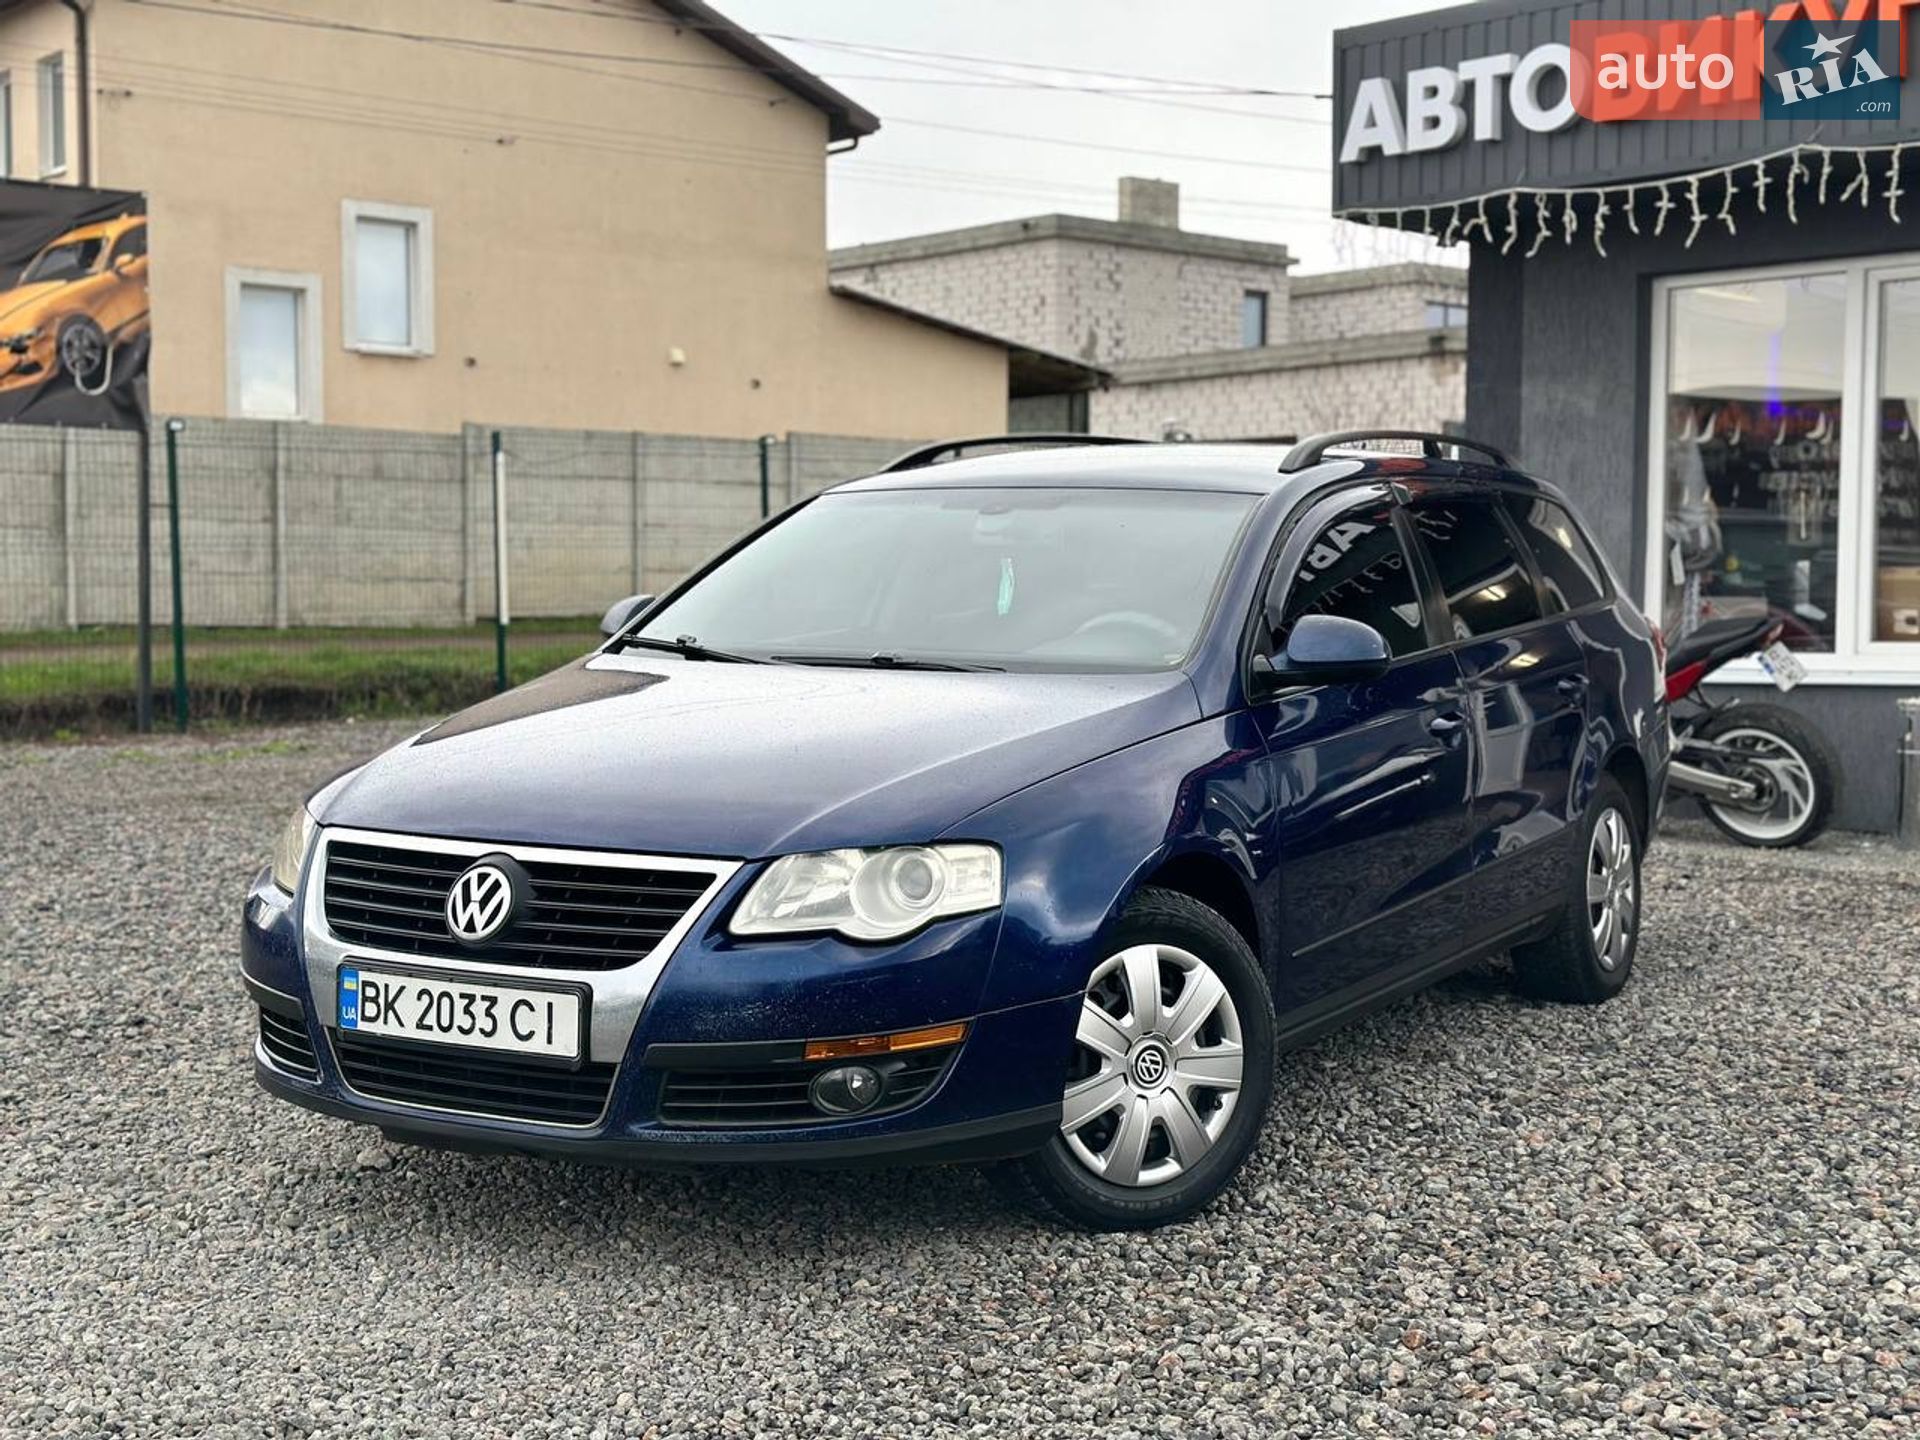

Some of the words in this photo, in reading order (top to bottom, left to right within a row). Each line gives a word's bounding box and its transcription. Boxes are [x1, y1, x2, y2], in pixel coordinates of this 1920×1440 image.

[342, 1005, 357, 1021] UA
[360, 980, 407, 1028] BK
[415, 988, 499, 1038] 2033
